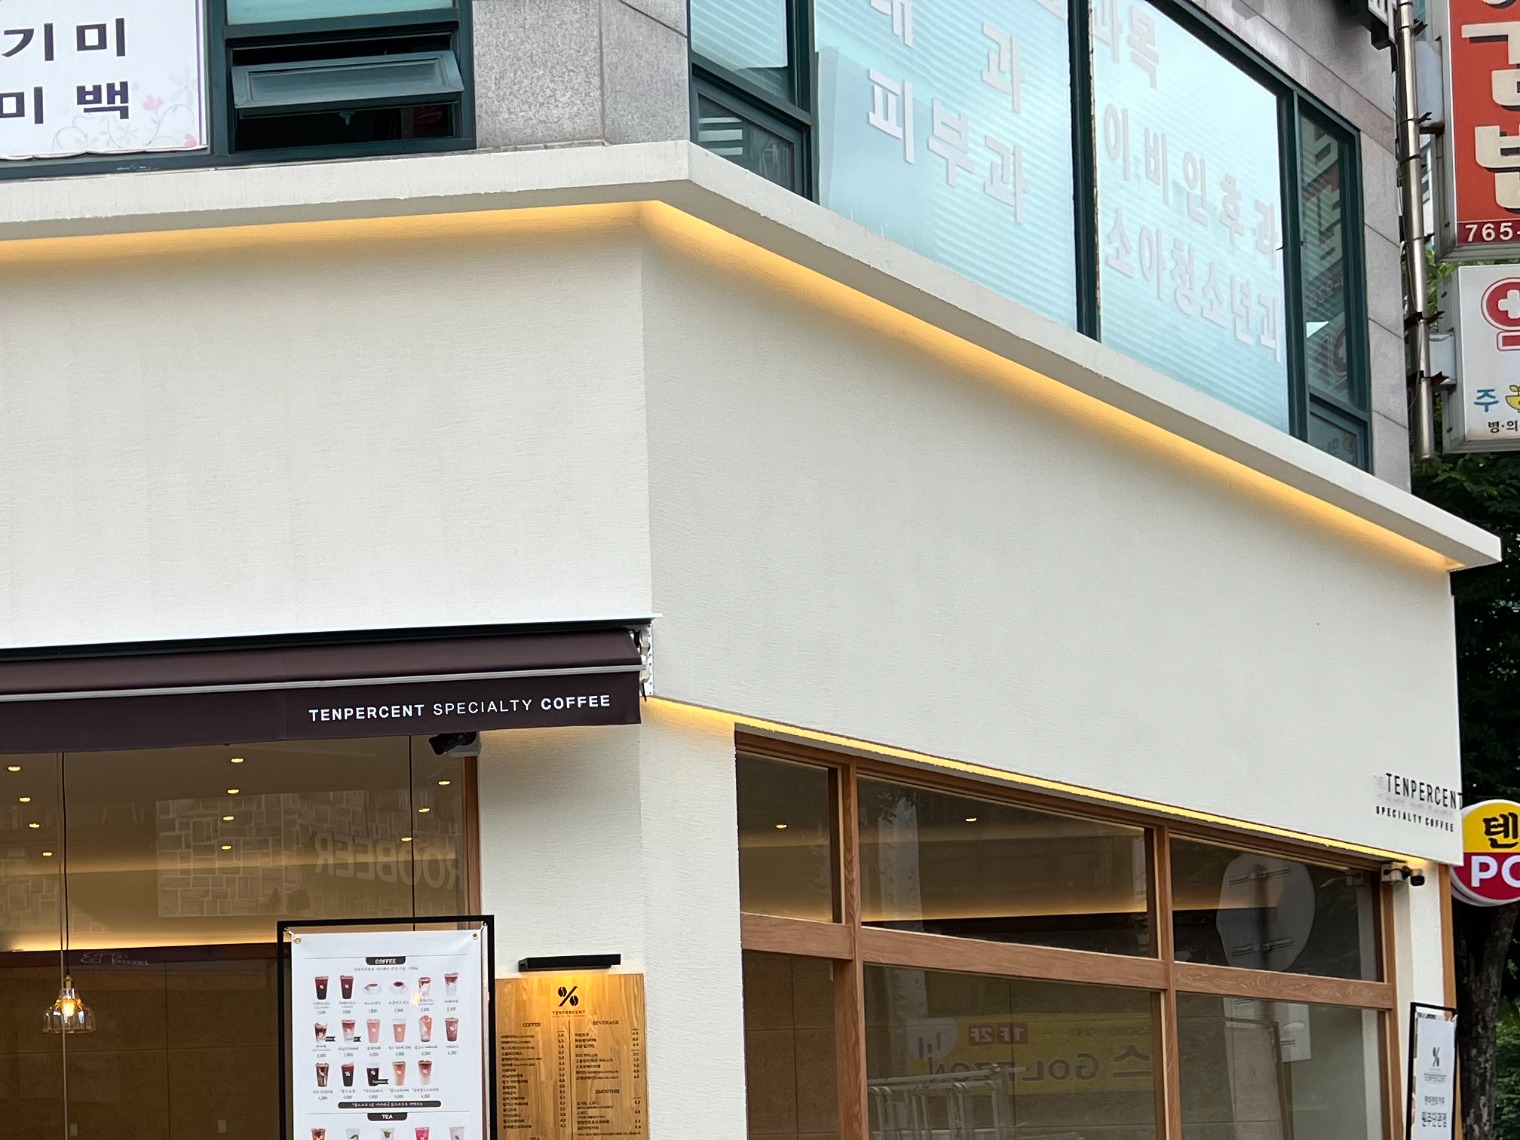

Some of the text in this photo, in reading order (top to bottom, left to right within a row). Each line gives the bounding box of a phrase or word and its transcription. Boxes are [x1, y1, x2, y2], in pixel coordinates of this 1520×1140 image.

[868, 67, 1029, 224] 피부과
[1103, 102, 1277, 271] 이비인후과
[1487, 419, 1520, 434] 병·의
[309, 694, 611, 722] TENPERCENT SPECIALTY COFFEE
[1385, 772, 1463, 810] TENPERCENT
[1376, 805, 1454, 833] SPECIALTY COFFEE
